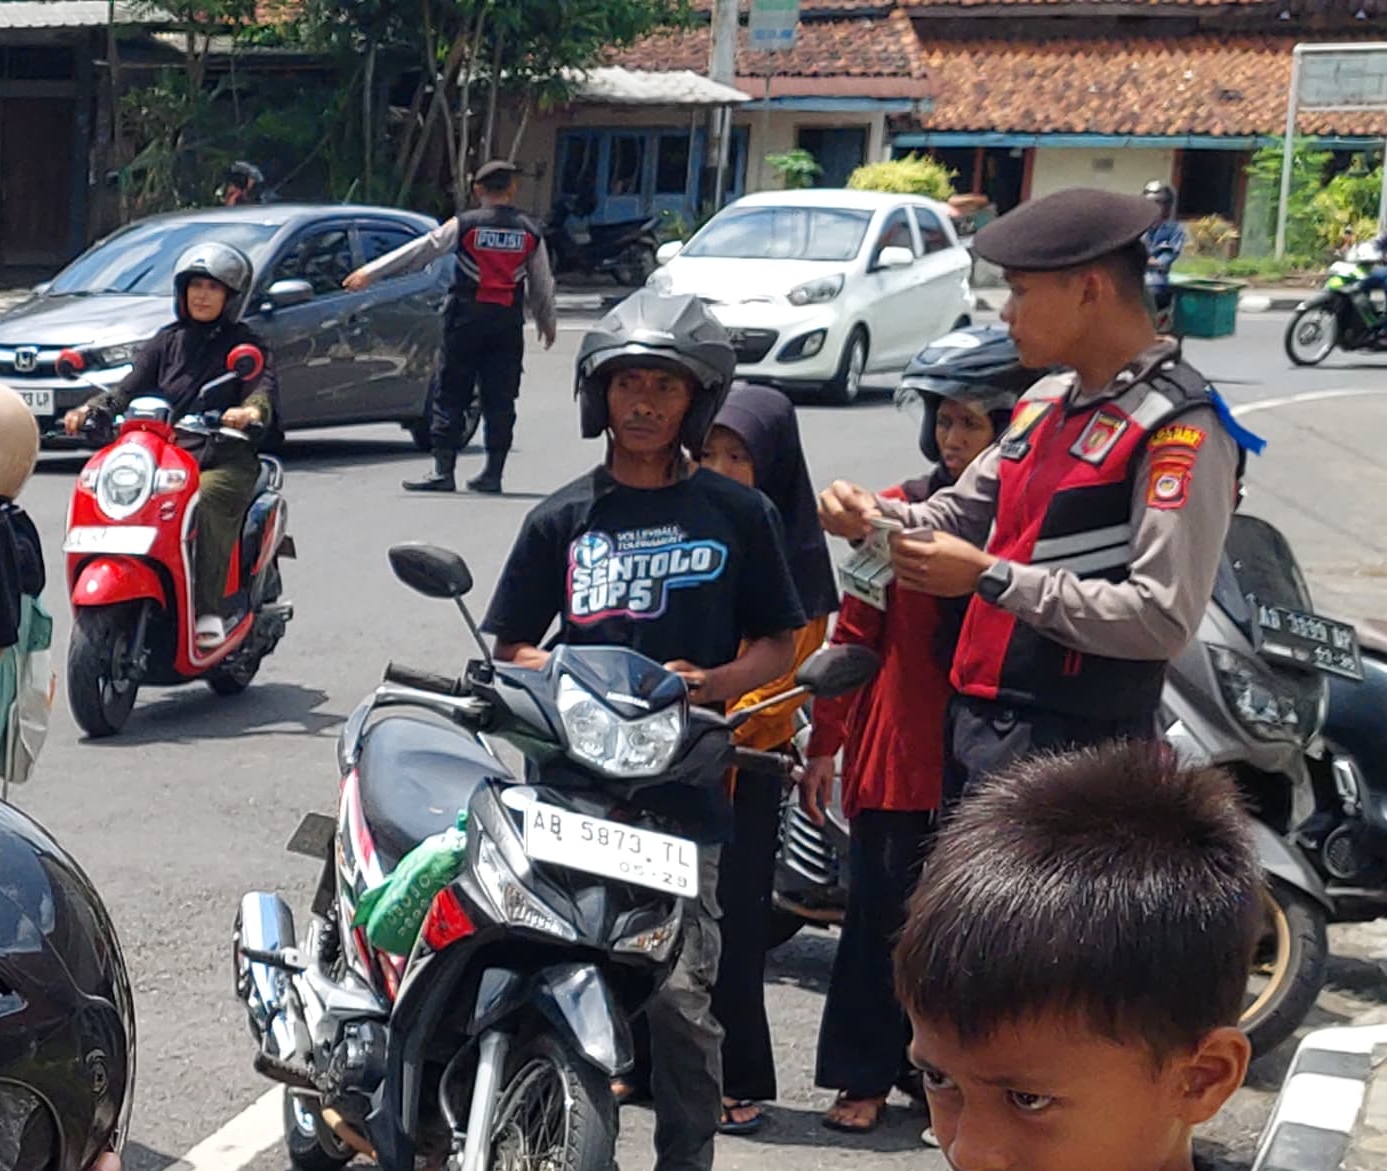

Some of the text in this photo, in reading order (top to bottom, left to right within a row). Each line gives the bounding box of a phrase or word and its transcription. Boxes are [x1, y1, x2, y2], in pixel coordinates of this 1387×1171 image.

[477, 231, 522, 249] POLISI
[572, 546, 713, 591] SENTOLO
[533, 809, 690, 868] AB 5873 TL
